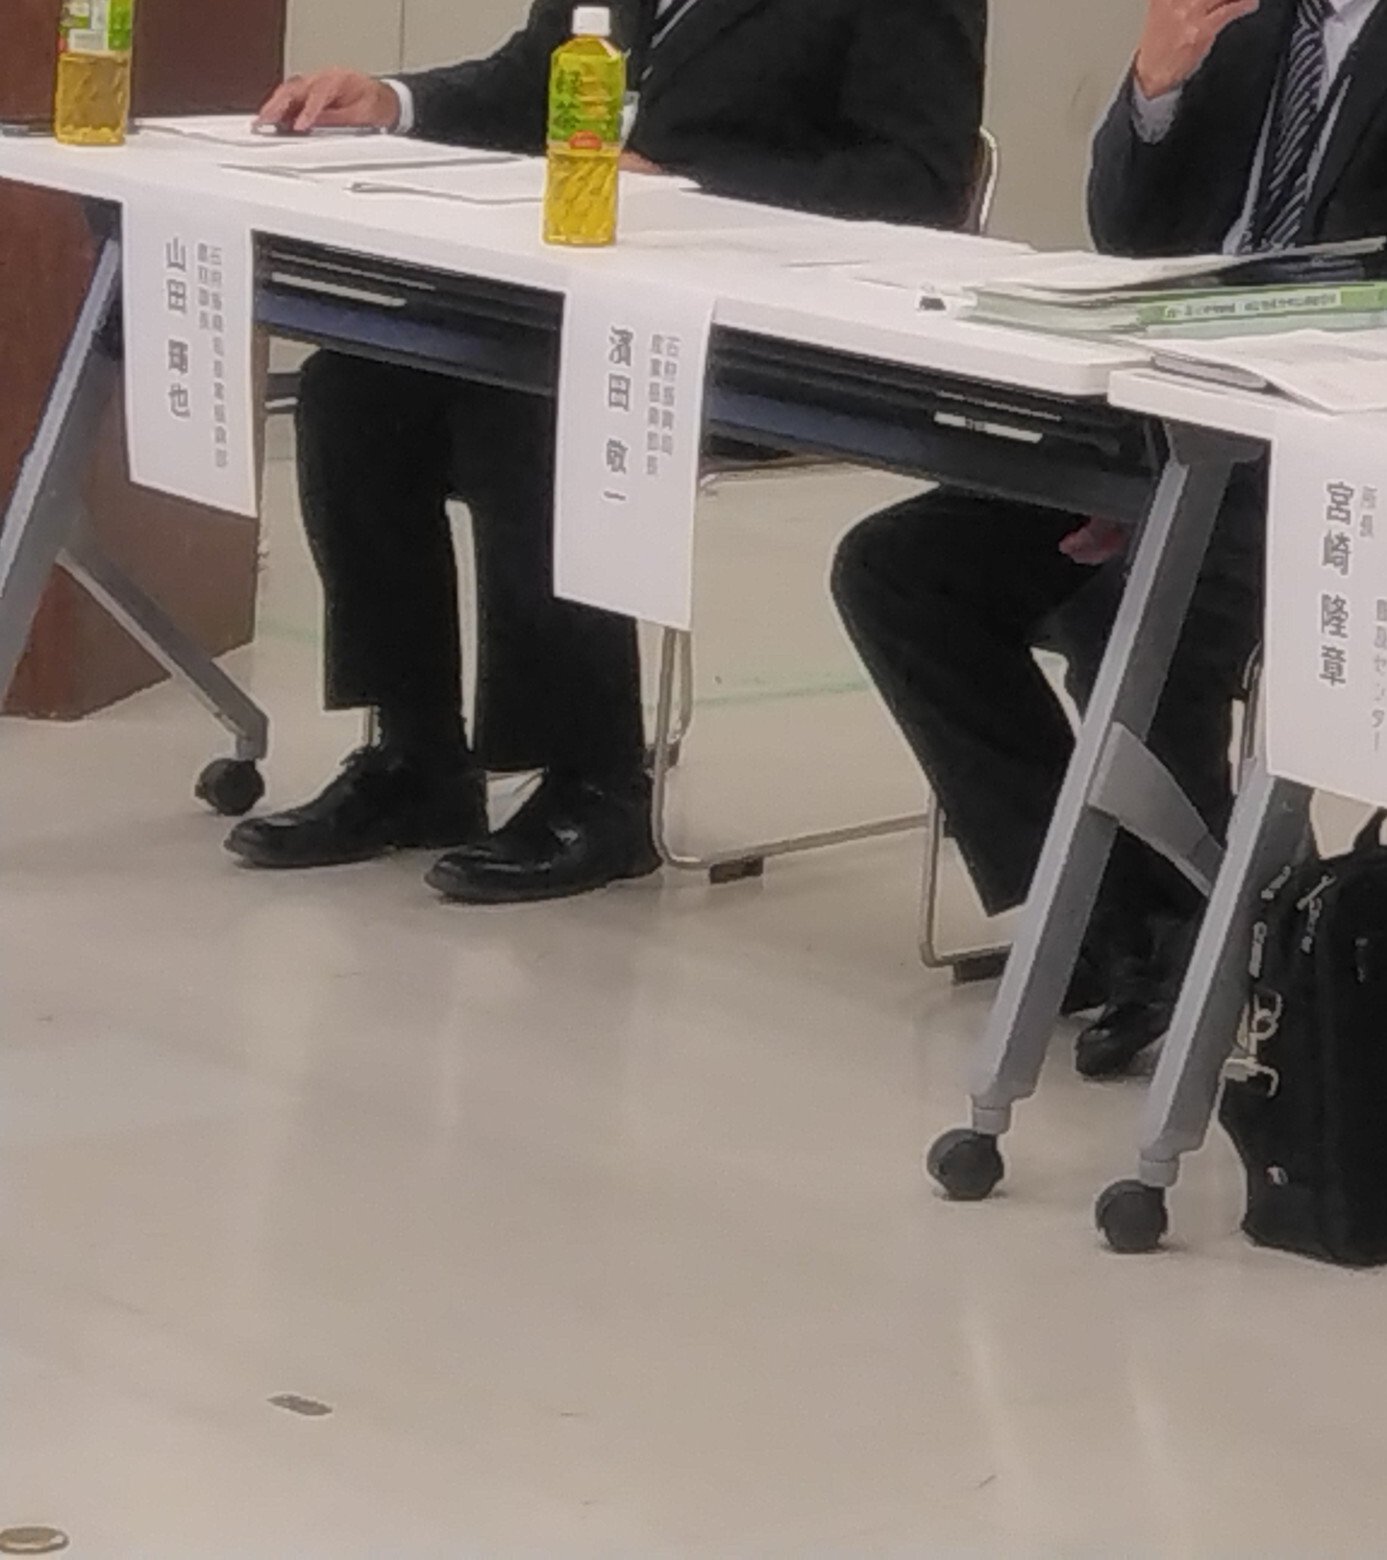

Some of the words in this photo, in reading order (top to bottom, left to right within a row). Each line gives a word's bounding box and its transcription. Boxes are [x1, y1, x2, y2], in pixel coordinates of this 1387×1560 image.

[166, 237, 187, 315] 山田
[1321, 481, 1355, 576] 宮崎
[1318, 593, 1350, 687] 隆章
